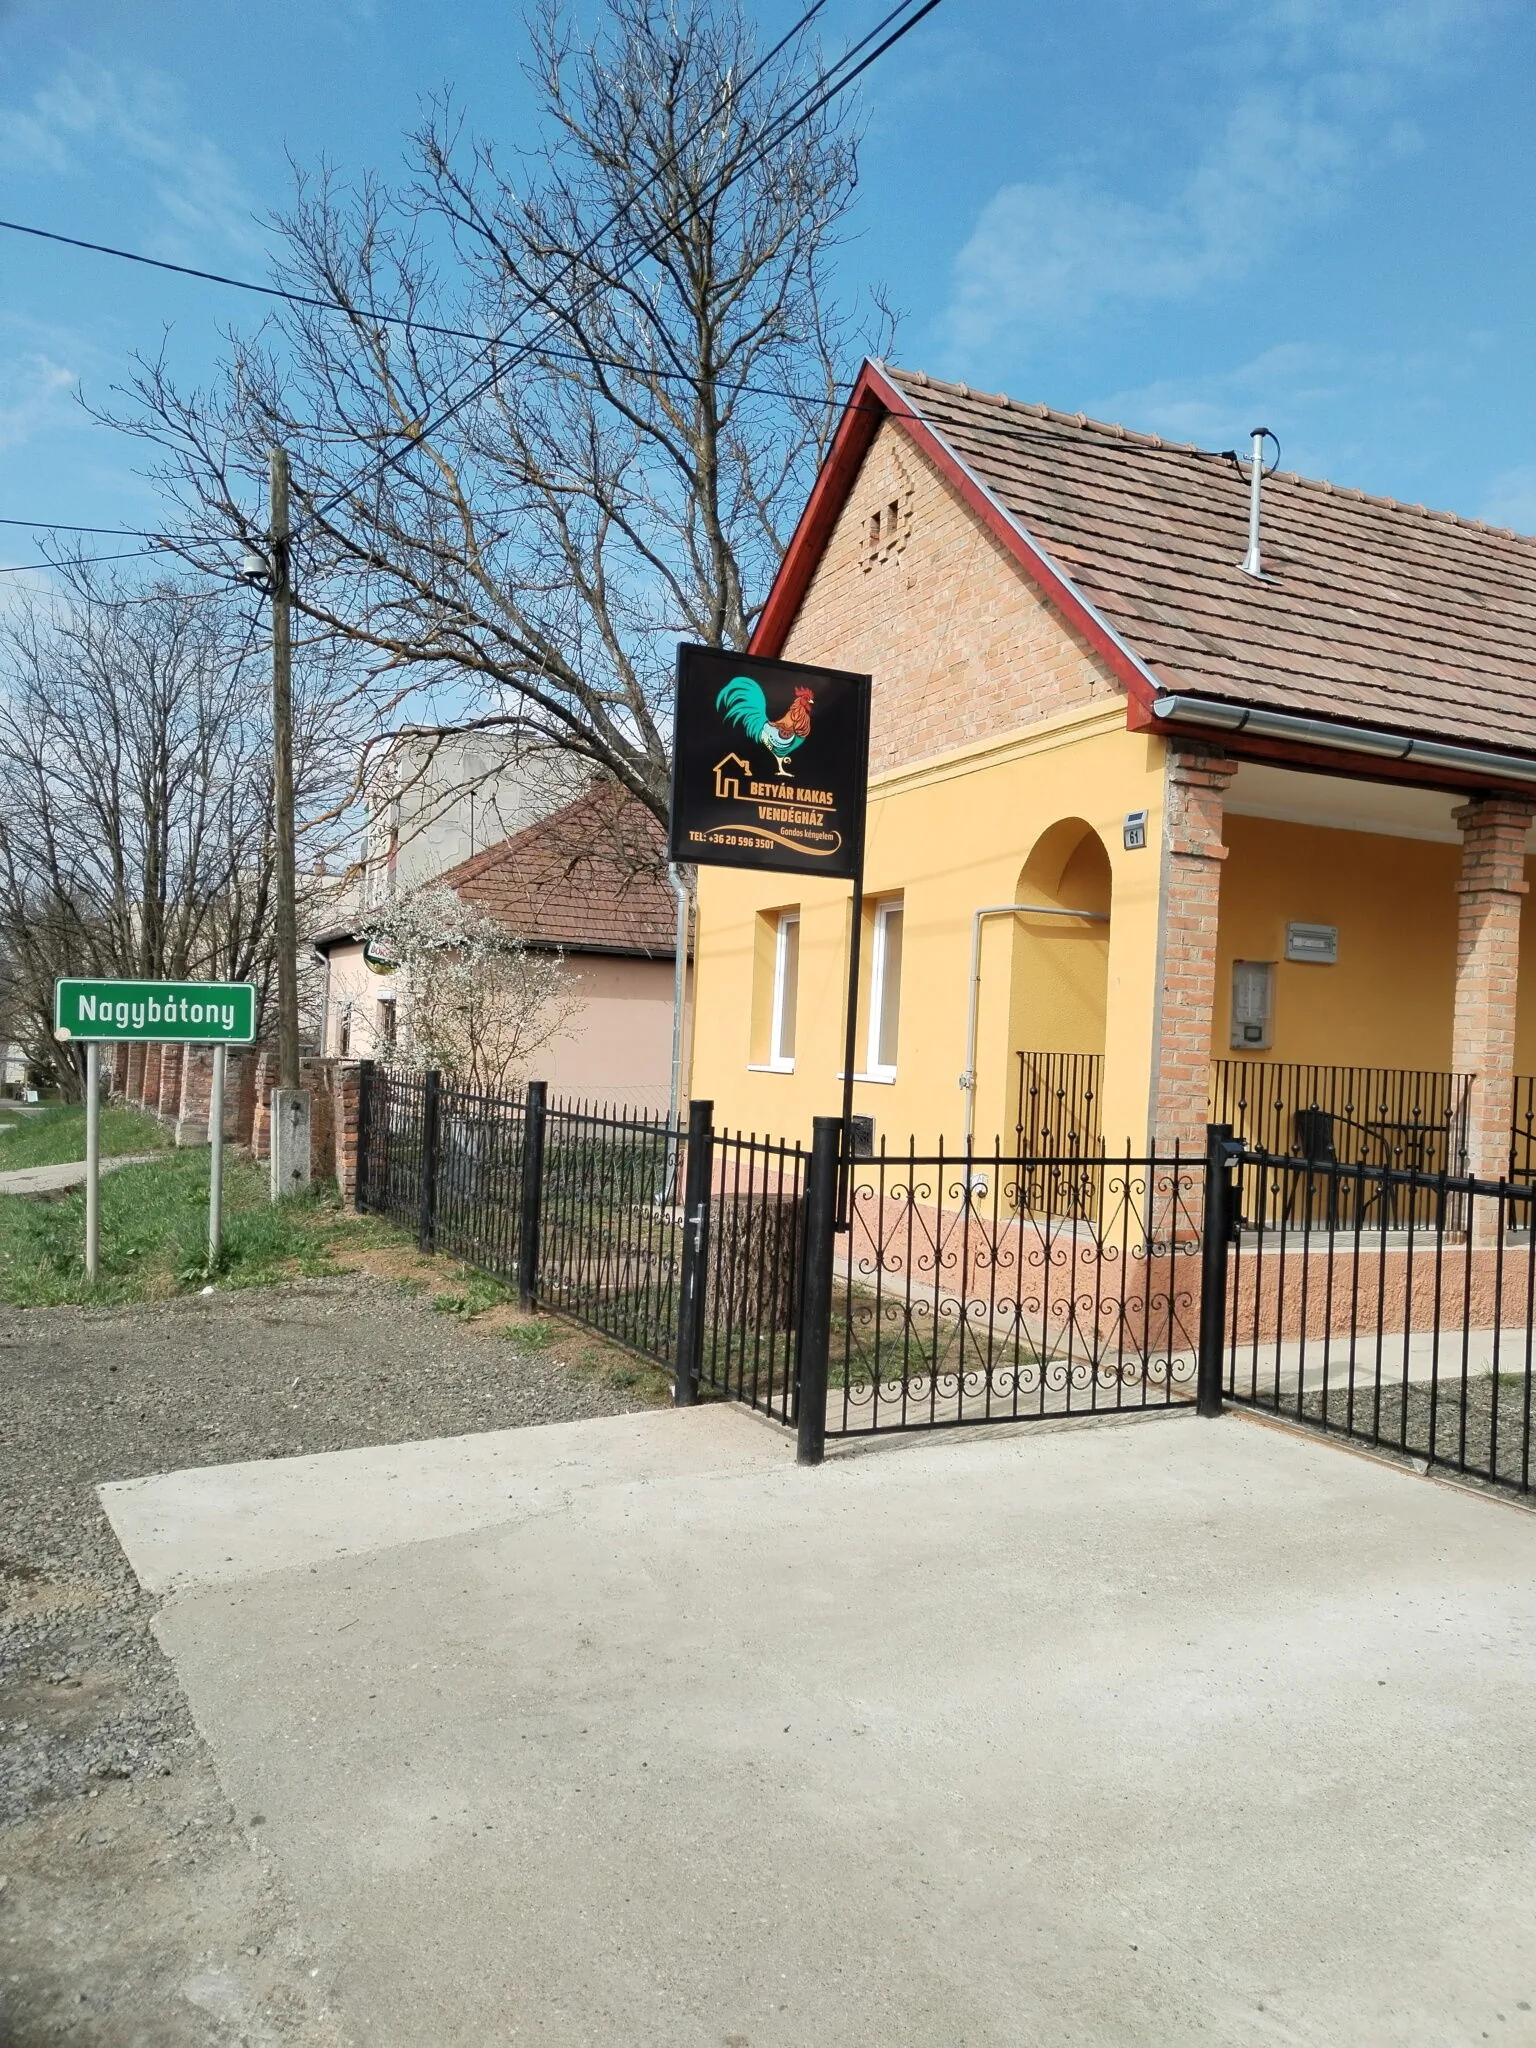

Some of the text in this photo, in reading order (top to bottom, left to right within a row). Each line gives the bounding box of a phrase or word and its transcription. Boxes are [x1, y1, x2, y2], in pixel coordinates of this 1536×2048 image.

[750, 782, 833, 805] BETYÁR KAKAS
[758, 806, 824, 827] VENDÉGHÁZ
[689, 830, 774, 849] TEL: +36 20 596 3501
[780, 827, 834, 841] Gondos kényelem
[1129, 830, 1139, 845] 61
[78, 994, 235, 1030] Nagybátony
